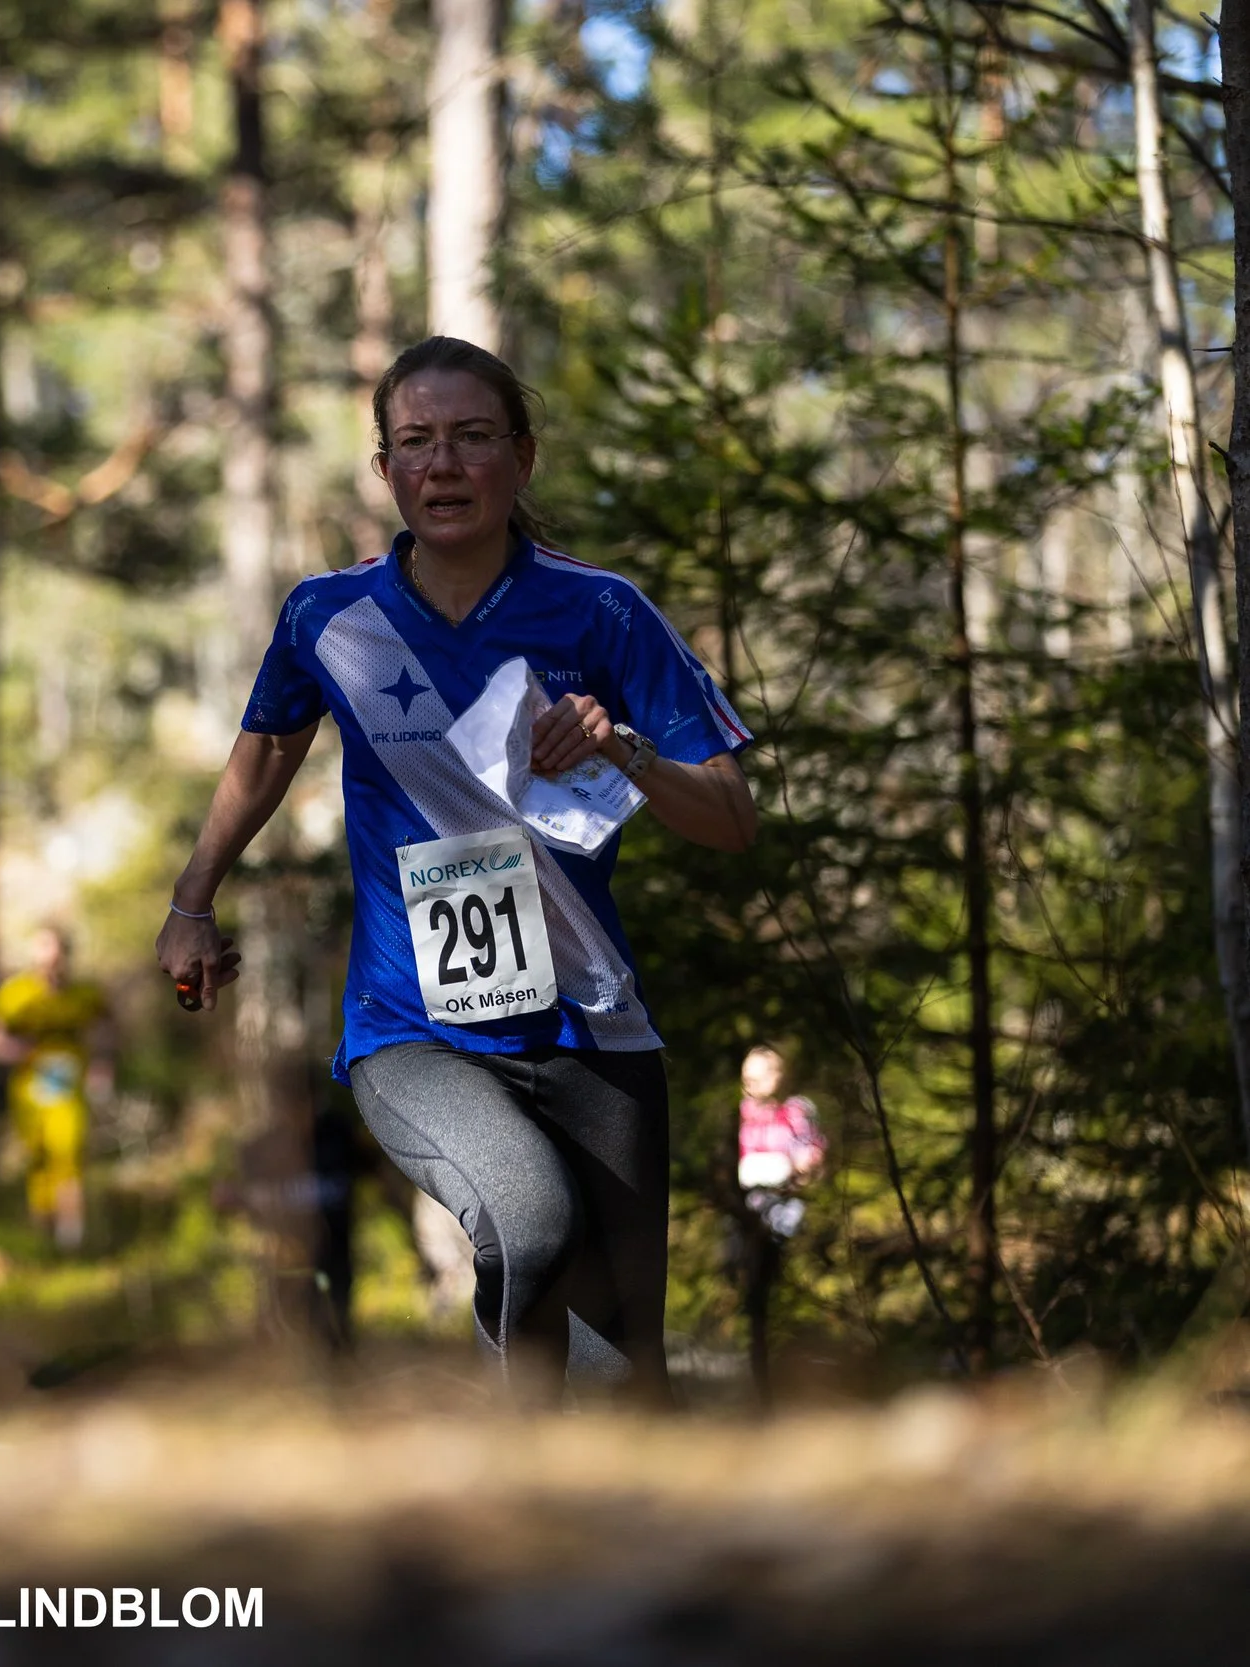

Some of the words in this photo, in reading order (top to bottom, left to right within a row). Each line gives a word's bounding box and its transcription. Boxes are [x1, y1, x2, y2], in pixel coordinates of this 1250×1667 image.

[476, 607, 491, 622] IFK
[372, 732, 390, 744] IFK
[410, 858, 488, 887] NOREX
[430, 886, 527, 986] 291
[446, 996, 474, 1014] OK
[479, 986, 538, 1009] Måsen
